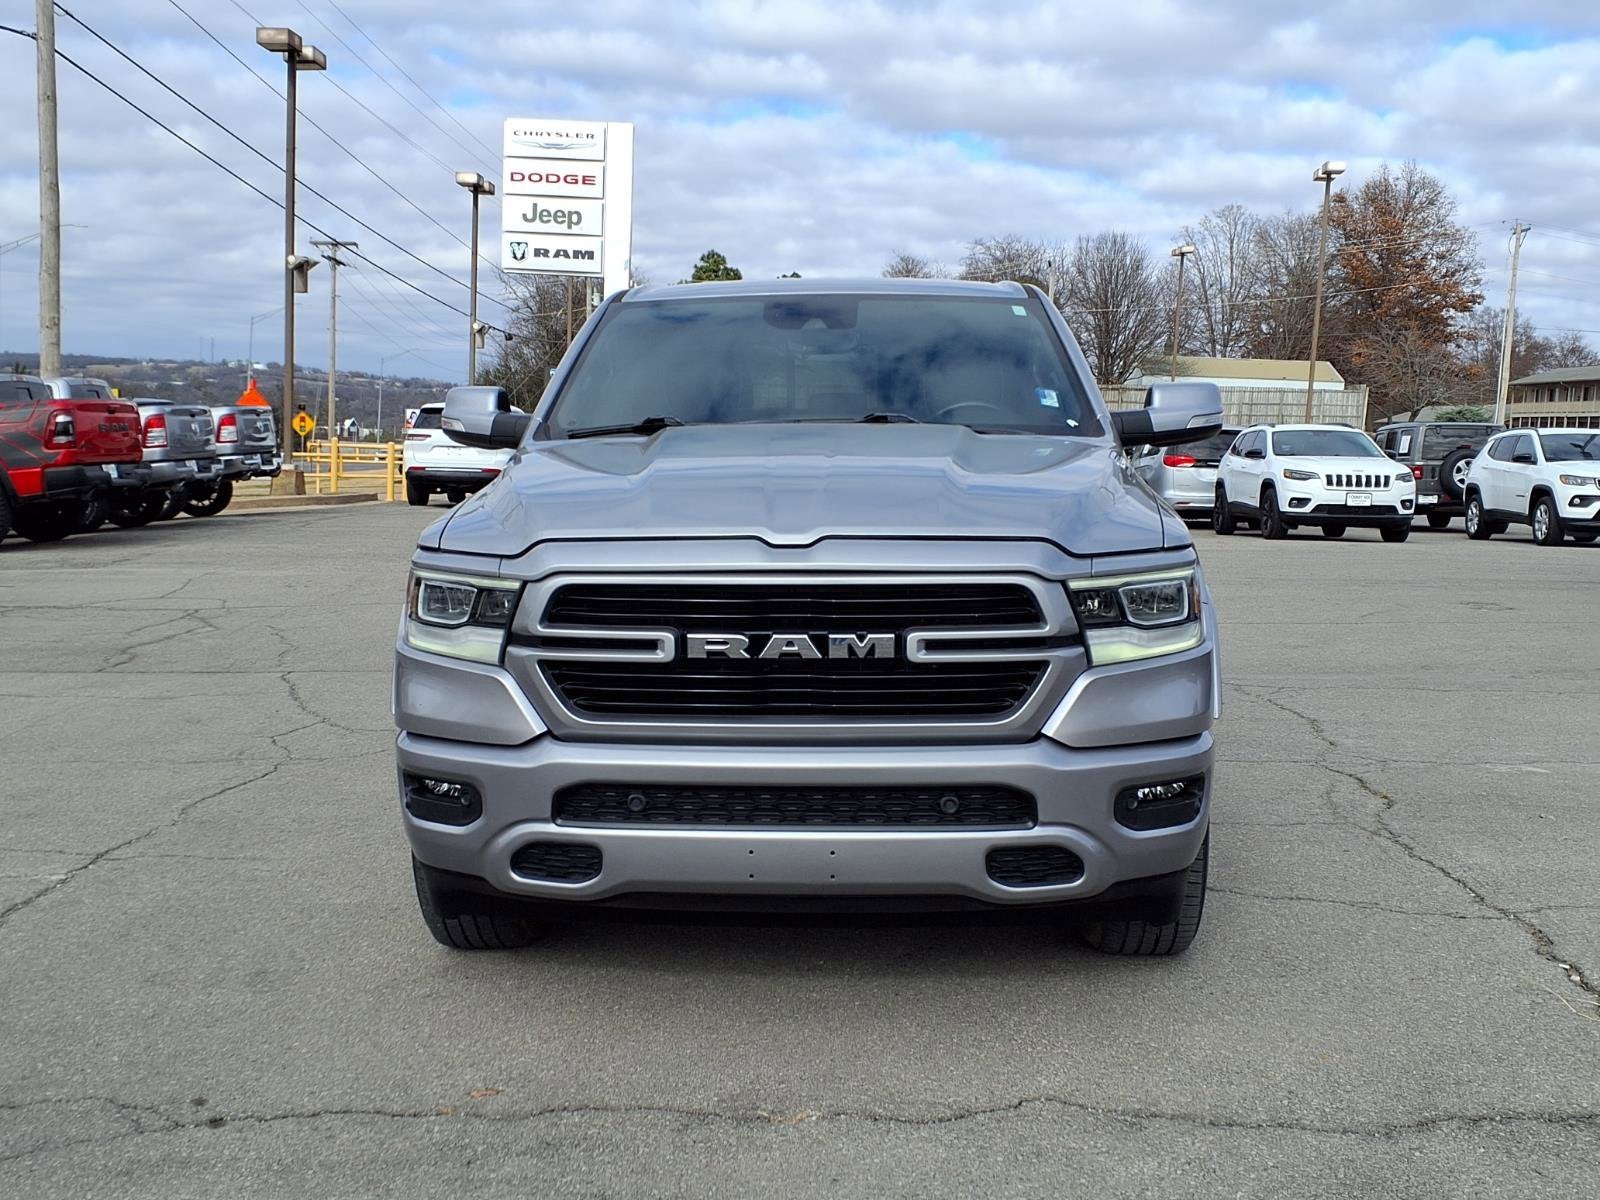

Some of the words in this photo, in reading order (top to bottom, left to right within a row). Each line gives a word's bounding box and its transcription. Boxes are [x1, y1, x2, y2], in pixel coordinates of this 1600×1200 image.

[513, 130, 595, 140] CHRYSLER
[510, 172, 596, 185] DODGE
[522, 203, 582, 229] Jeep
[533, 248, 595, 260] RAM
[686, 633, 896, 659] RAM
